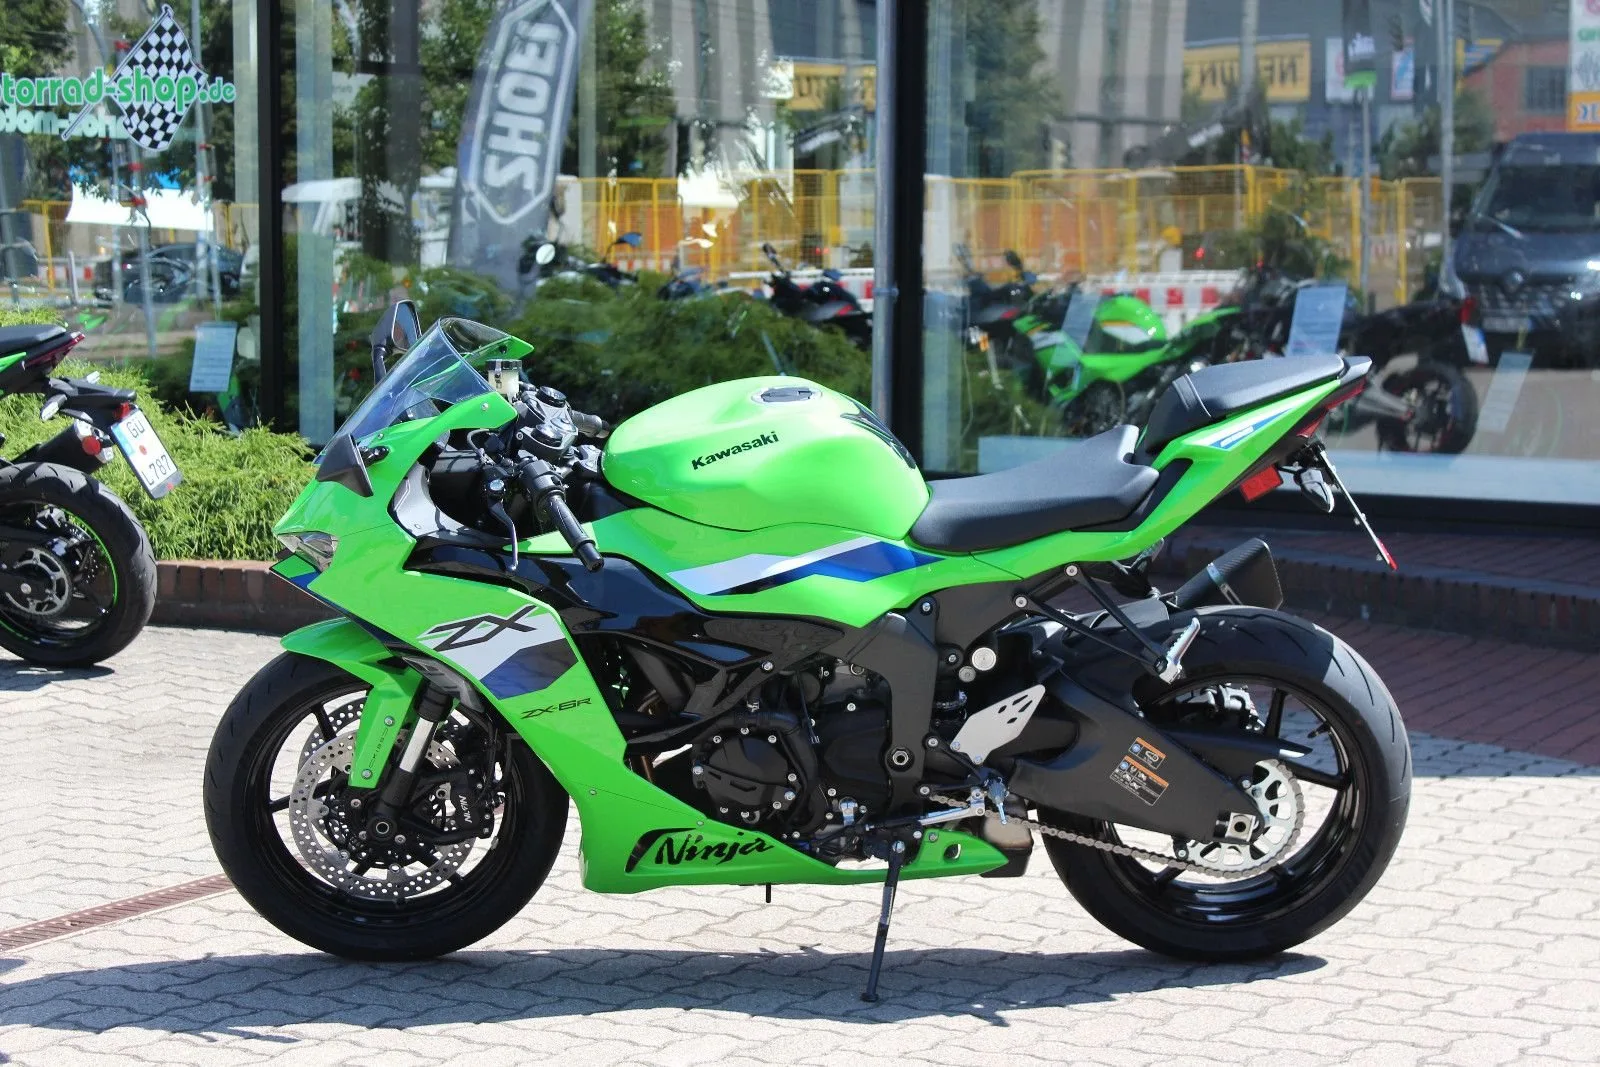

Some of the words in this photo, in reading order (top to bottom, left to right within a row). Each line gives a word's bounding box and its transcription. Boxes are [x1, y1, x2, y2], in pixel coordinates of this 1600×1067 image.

[0, 67, 236, 115] torrad-shop.de
[484, 20, 563, 191] SHOEI
[691, 430, 779, 470] Kawasaki
[427, 604, 538, 652] ZX
[520, 697, 592, 720] ZX-6R
[654, 832, 775, 866] Ninja
